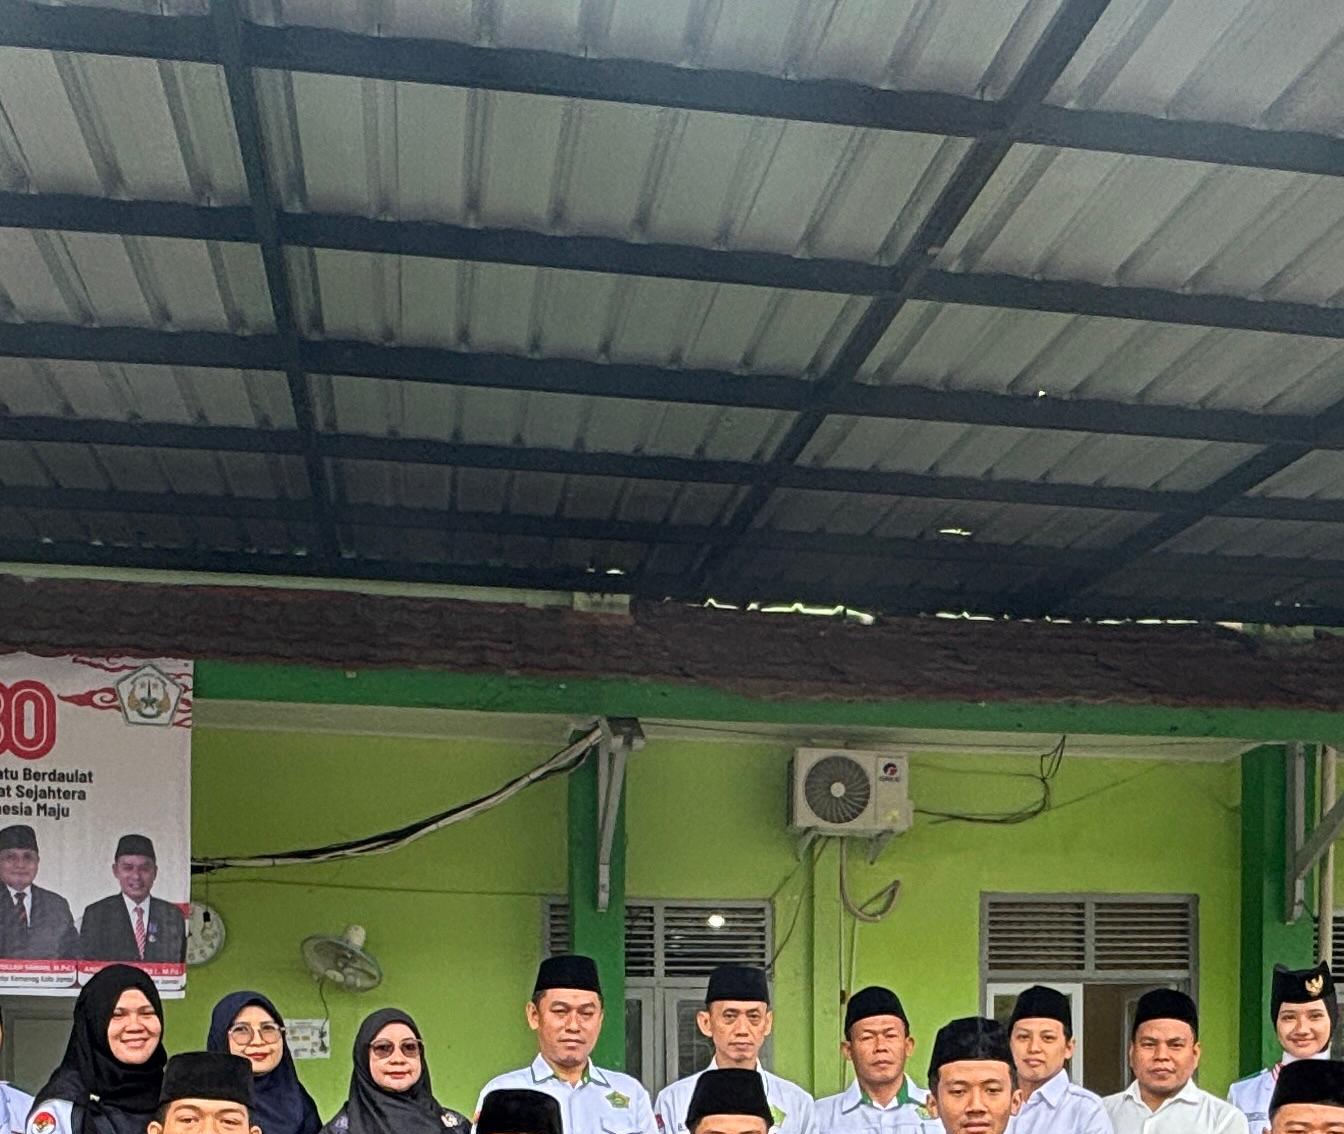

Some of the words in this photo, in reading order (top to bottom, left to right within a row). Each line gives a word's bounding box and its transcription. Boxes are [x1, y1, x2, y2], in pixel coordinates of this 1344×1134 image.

[22, 767, 94, 784] Berdaulat
[15, 784, 86, 802] Sejahtera
[36, 802, 70, 820] Maju
